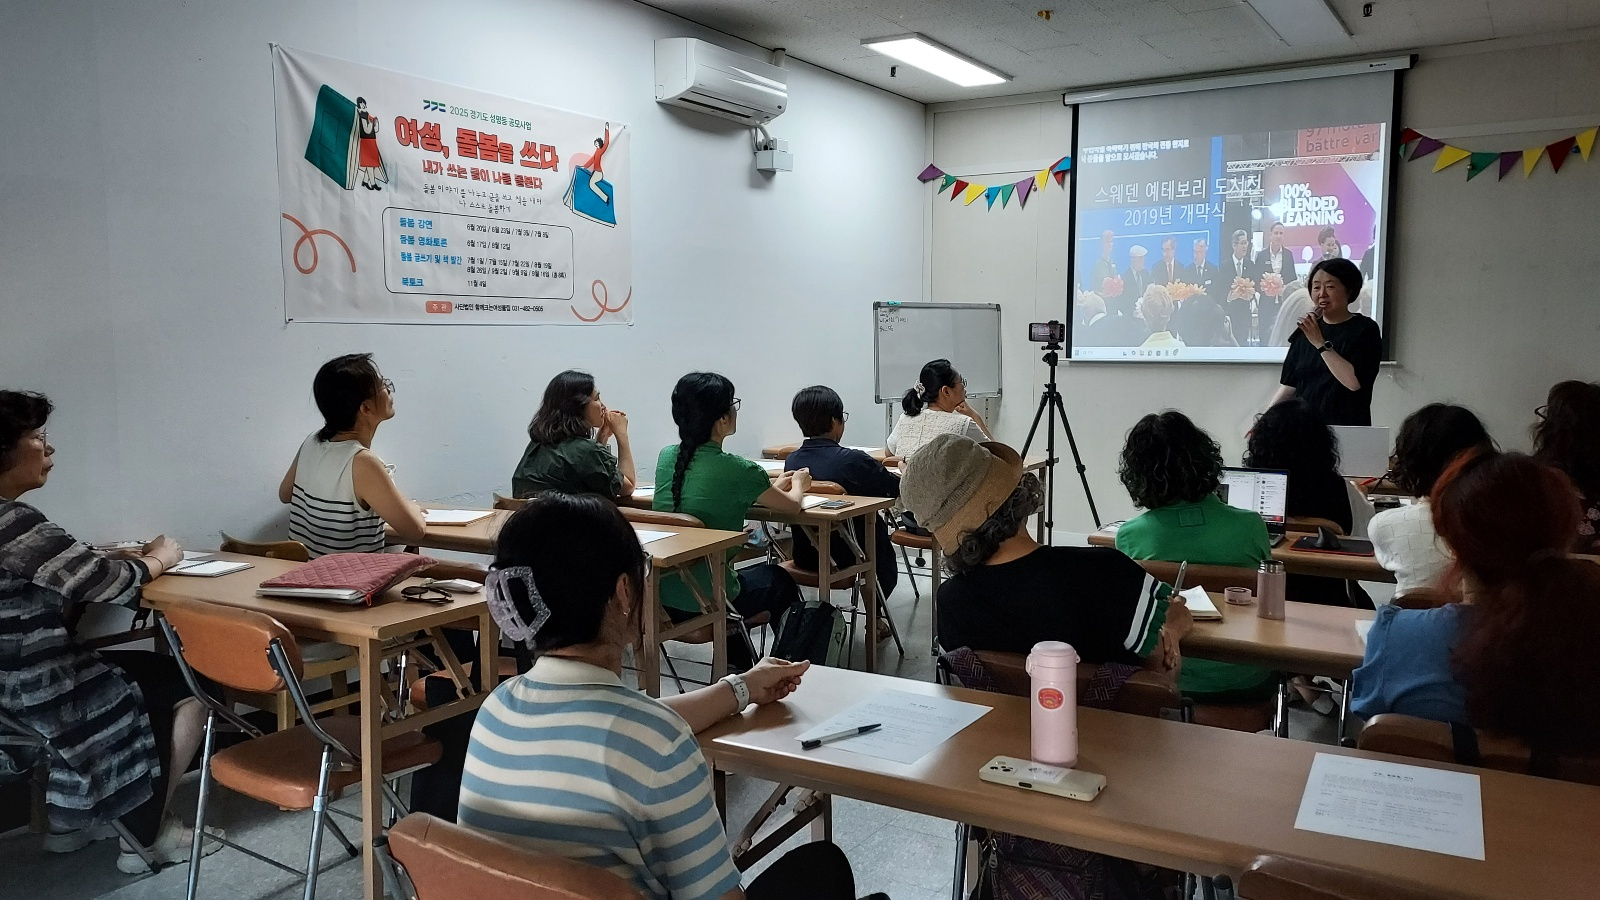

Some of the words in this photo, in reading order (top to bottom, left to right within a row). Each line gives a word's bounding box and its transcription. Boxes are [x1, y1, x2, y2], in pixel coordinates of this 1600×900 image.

[450, 106, 469, 117] 2025
[470, 110, 489, 122] 경기도
[509, 118, 532, 131] 공모사업
[394, 115, 449, 159] 여성,
[456, 127, 514, 164] 돌봄을
[519, 140, 560, 172] 쓰다
[1306, 137, 1349, 153] bättre
[422, 159, 444, 175] 내가
[447, 163, 468, 179] 쓰는
[470, 167, 491, 183] 글이
[492, 171, 512, 185] 나를
[1094, 182, 1139, 204] 스웨덴
[1145, 178, 1206, 202] 예테보리
[1279, 182, 1312, 199] 100%
[1280, 195, 1339, 212] BLENDED
[1124, 206, 1172, 226] 2019년
[1179, 201, 1226, 224] 개막식
[1280, 209, 1345, 227] LEARNING
[400, 217, 415, 228] 돌봄
[418, 219, 433, 230] 강연
[400, 234, 415, 245] 돌봄
[418, 236, 448, 248] 영화토론
[400, 251, 413, 262] 돌봄
[414, 252, 432, 263] 글쓰기
[434, 254, 441, 264] 및
[450, 255, 463, 266] 발간
[402, 277, 424, 287] 북토크
[454, 303, 474, 311] 사단법인
